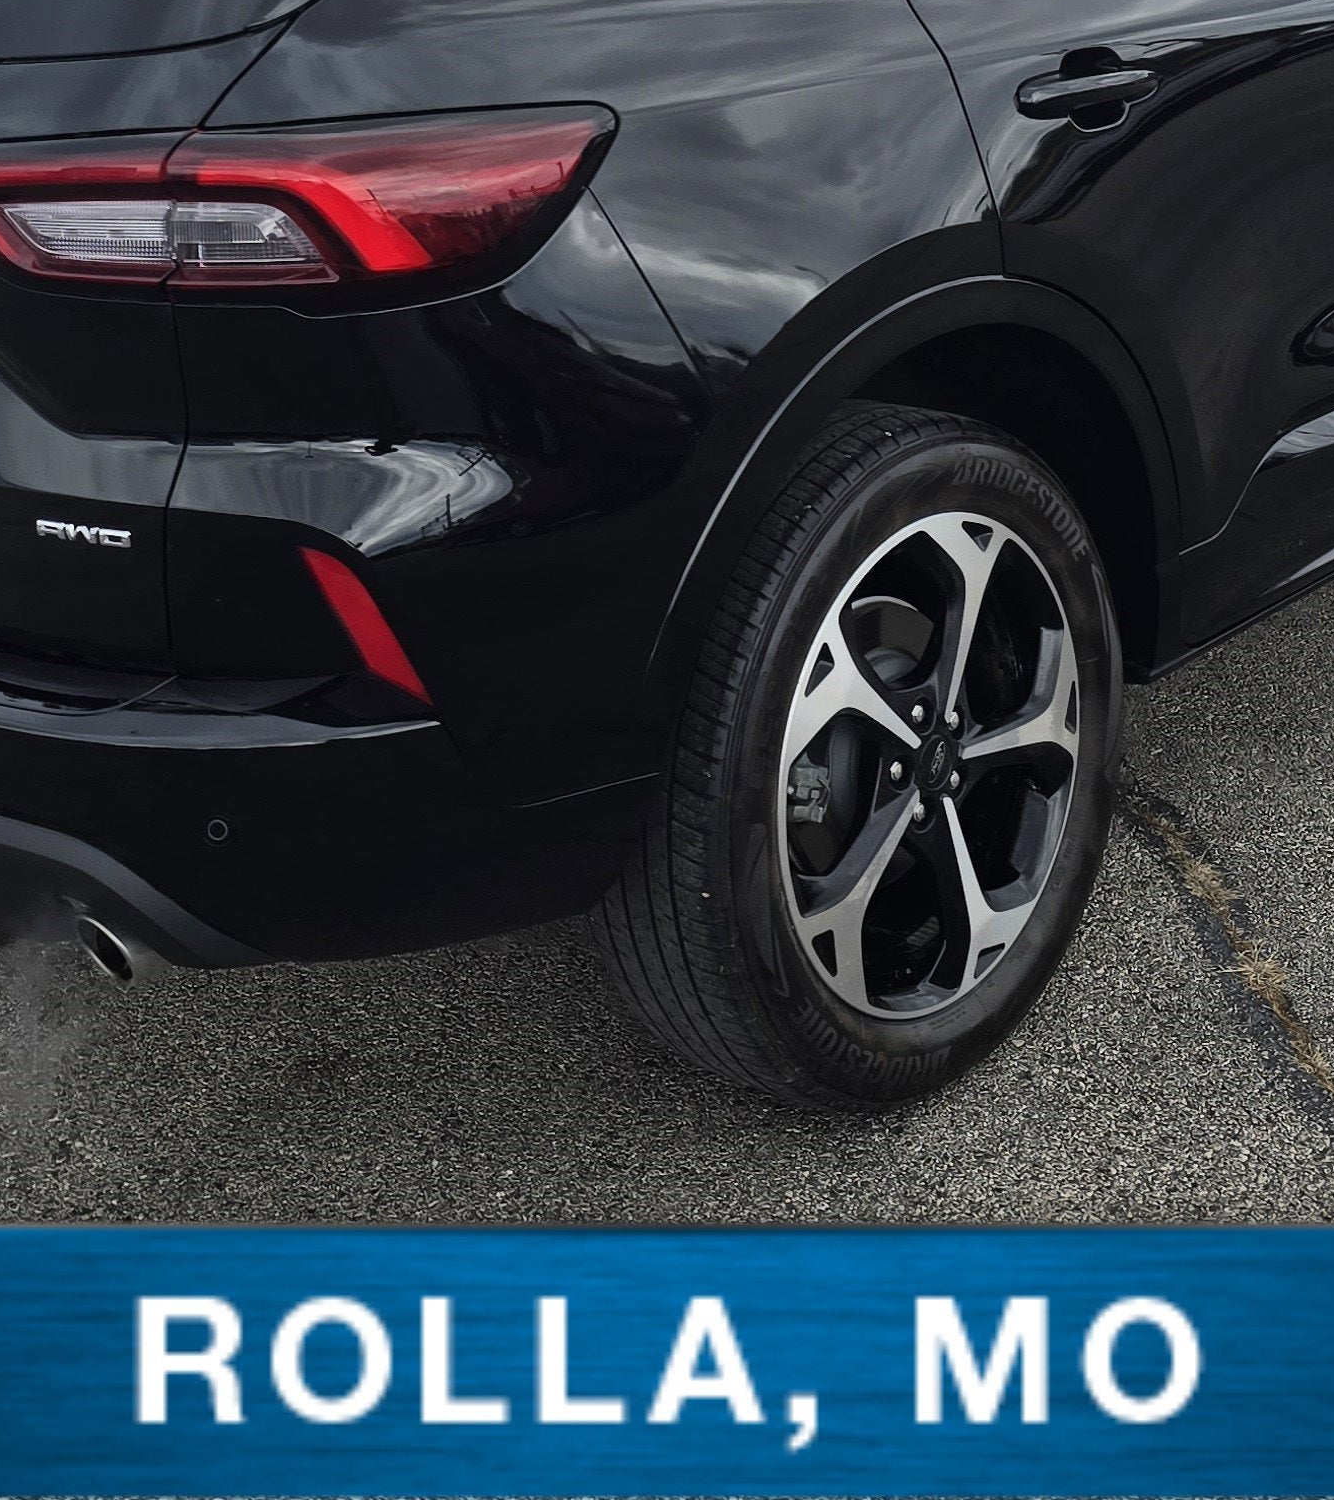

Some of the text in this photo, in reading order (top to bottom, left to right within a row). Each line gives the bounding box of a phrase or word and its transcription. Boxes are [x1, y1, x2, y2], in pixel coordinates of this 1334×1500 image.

[35, 519, 132, 549] AWD
[950, 451, 1090, 562] BRIDGESTONE
[790, 996, 952, 1086] BRIDGESTONE
